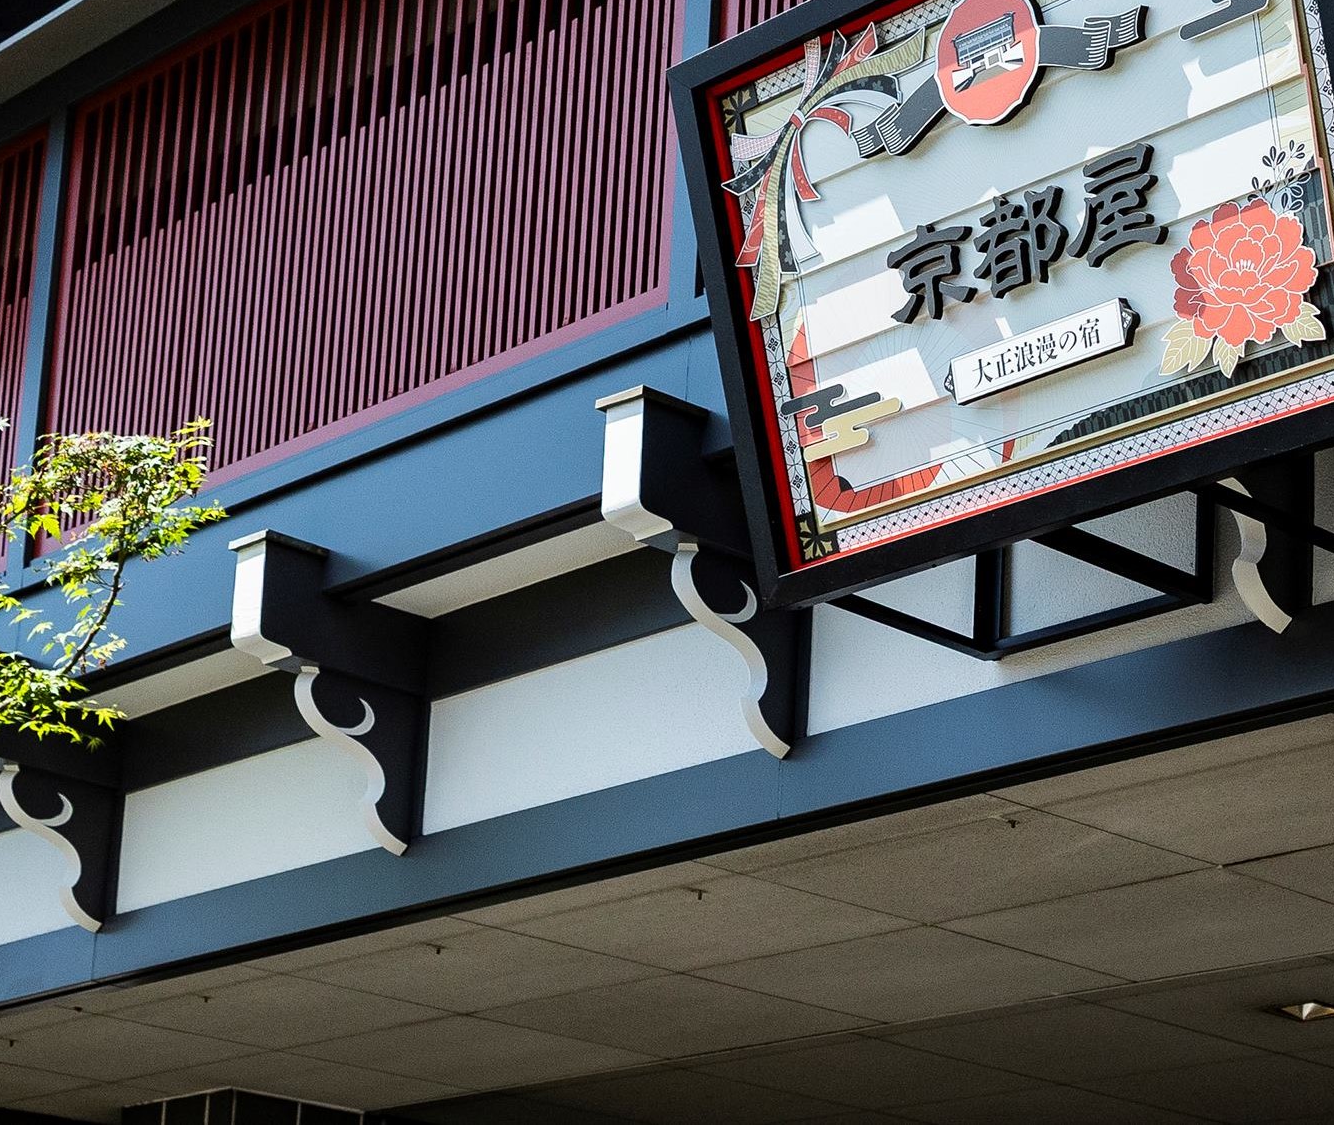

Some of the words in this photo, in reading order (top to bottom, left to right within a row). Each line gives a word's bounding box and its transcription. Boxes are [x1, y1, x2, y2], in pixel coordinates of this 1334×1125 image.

[887, 143, 1169, 324] 京都屋
[971, 318, 1101, 388] 大正浪漫の宿
